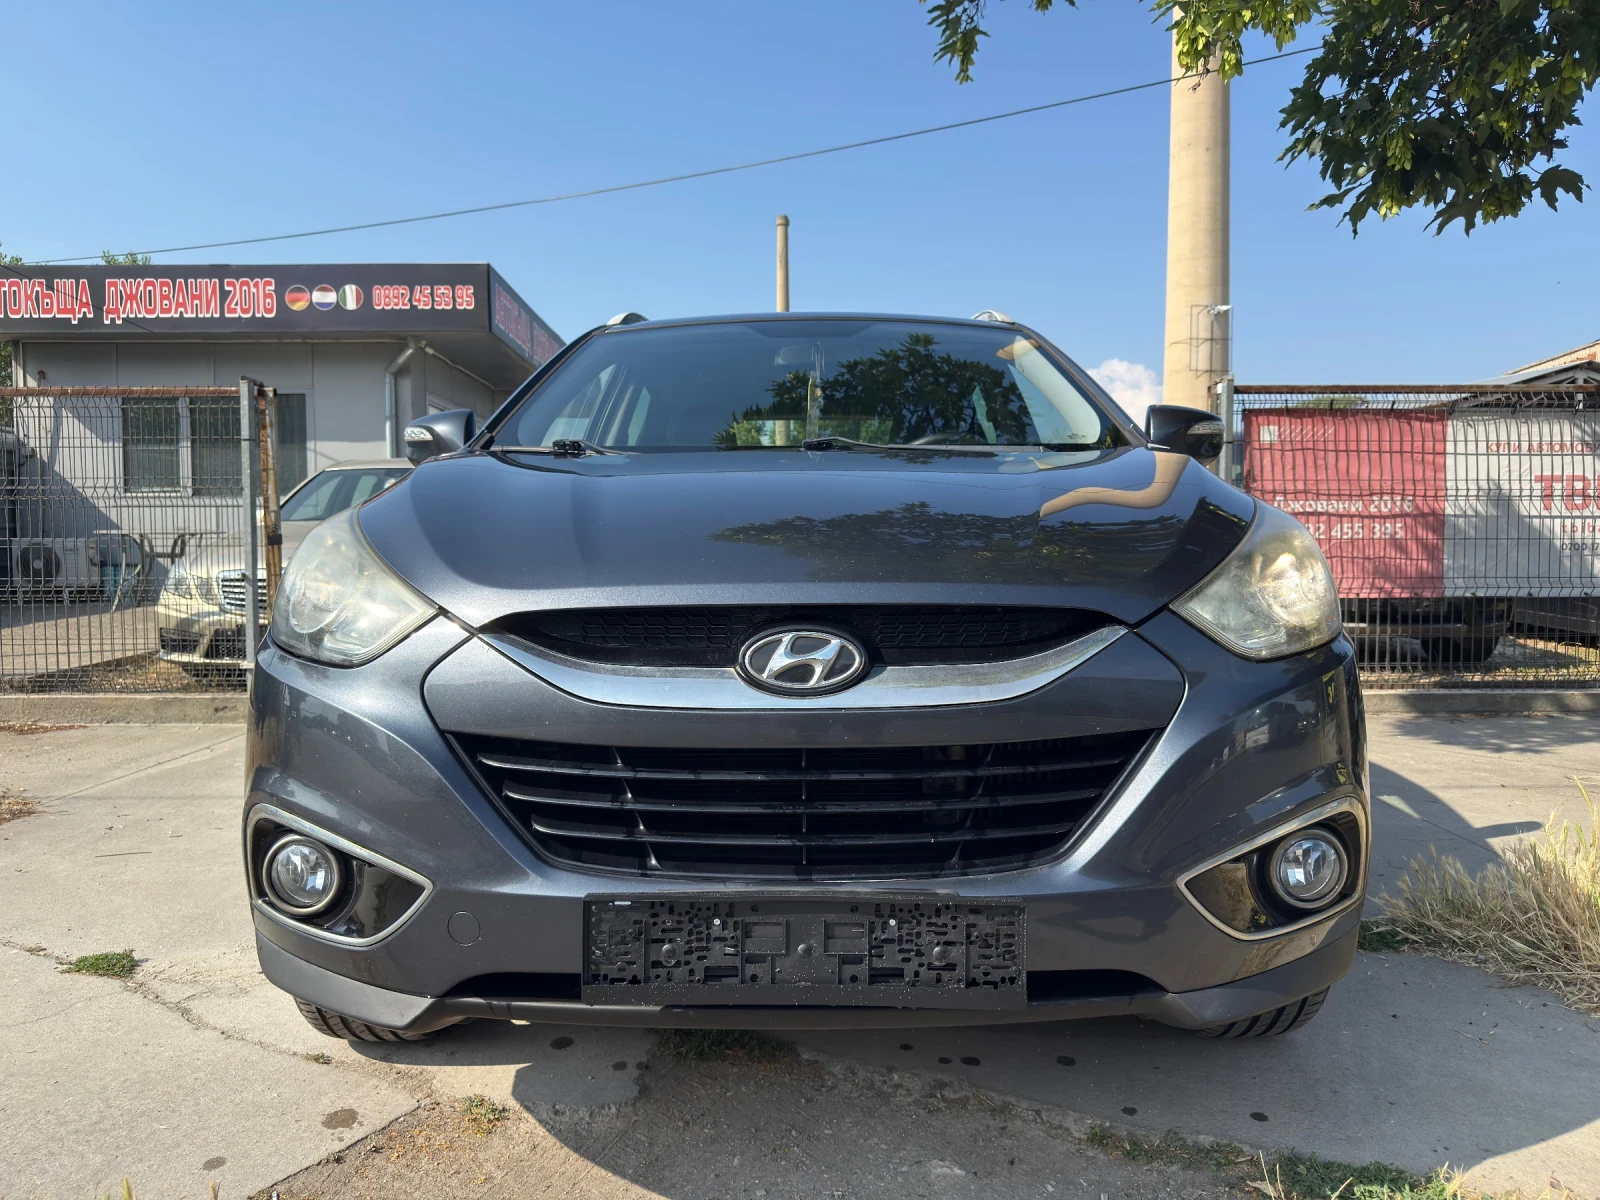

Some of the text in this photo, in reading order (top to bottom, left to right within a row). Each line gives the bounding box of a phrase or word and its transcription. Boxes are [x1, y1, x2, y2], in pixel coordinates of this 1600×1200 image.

[104, 278, 220, 324] ДЖОВАНИ
[224, 278, 277, 318] 2016
[373, 285, 474, 309] 0892 45 53 95
[1369, 496, 1414, 512] 2016
[1331, 523, 1364, 539] 455
[1371, 523, 1404, 539] 395
[1561, 543, 1587, 551] 0700
